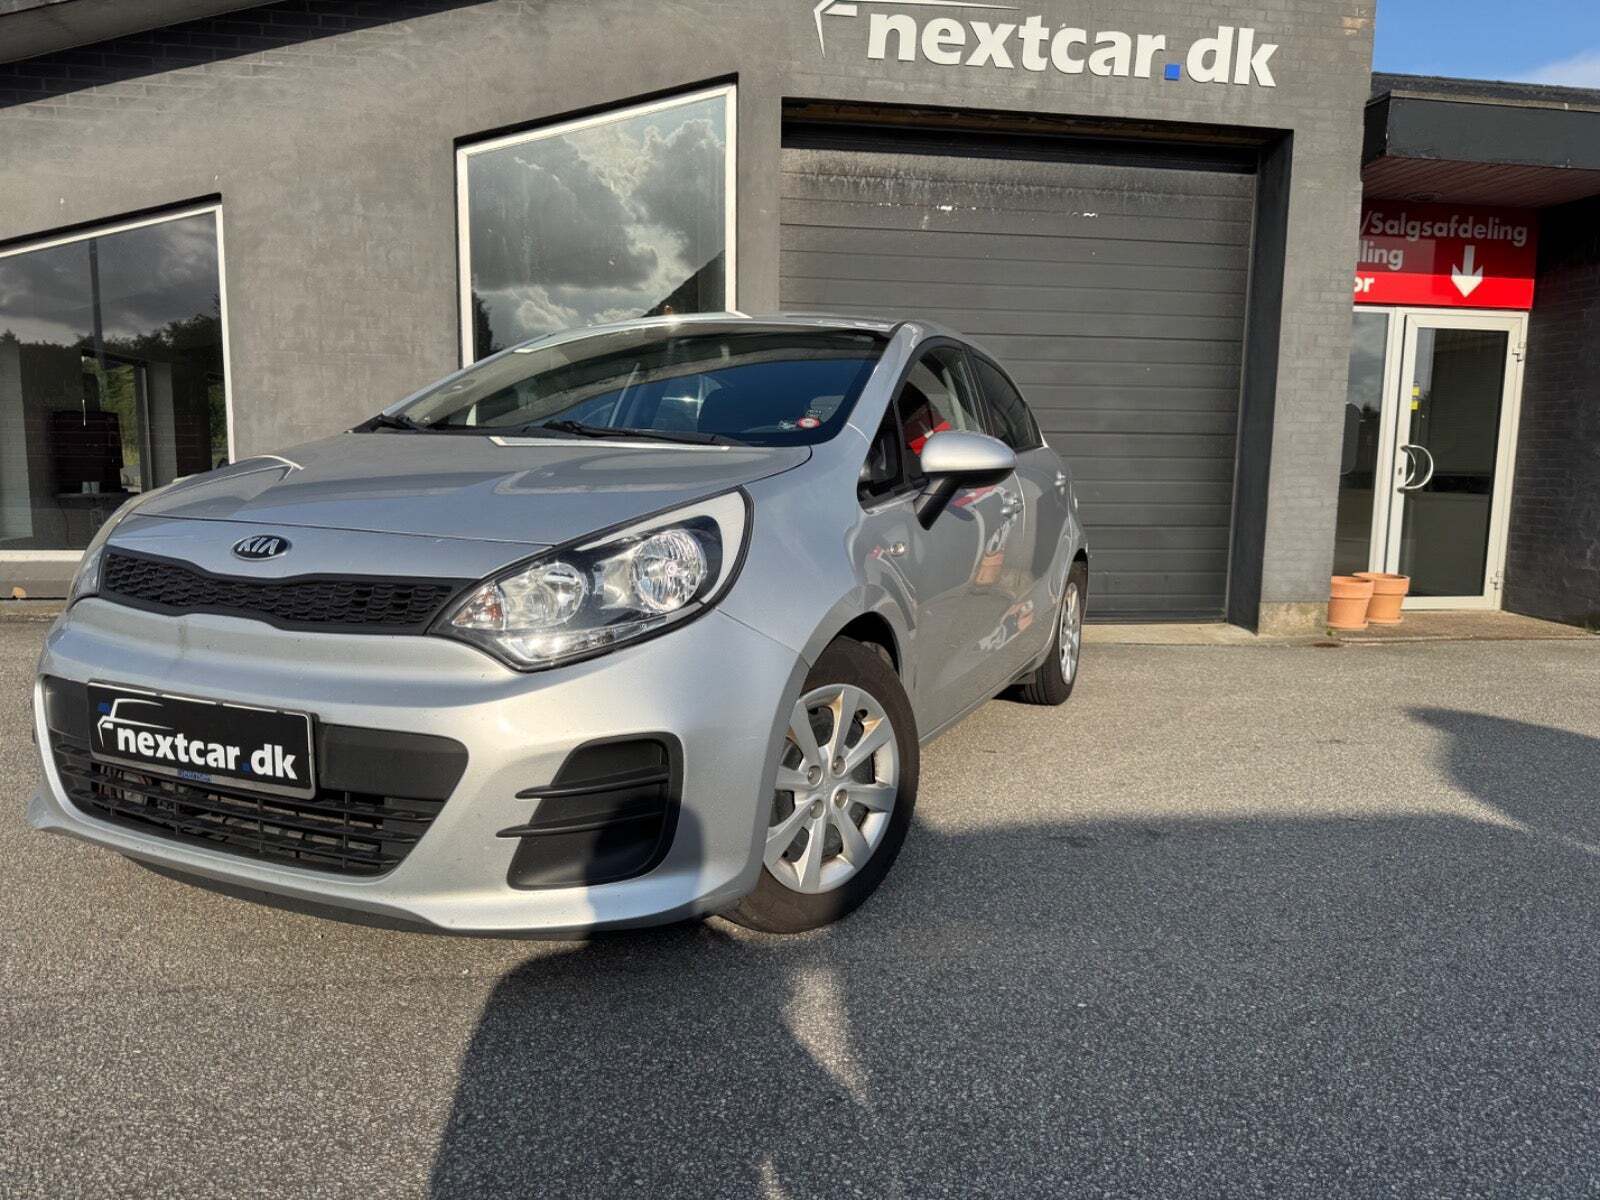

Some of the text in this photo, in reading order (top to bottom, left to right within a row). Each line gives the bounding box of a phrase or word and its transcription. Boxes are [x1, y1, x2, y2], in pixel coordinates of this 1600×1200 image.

[867, 13, 1279, 87] nextcar.dk
[238, 537, 279, 555] KIA
[117, 727, 298, 780] nextcar.dk
